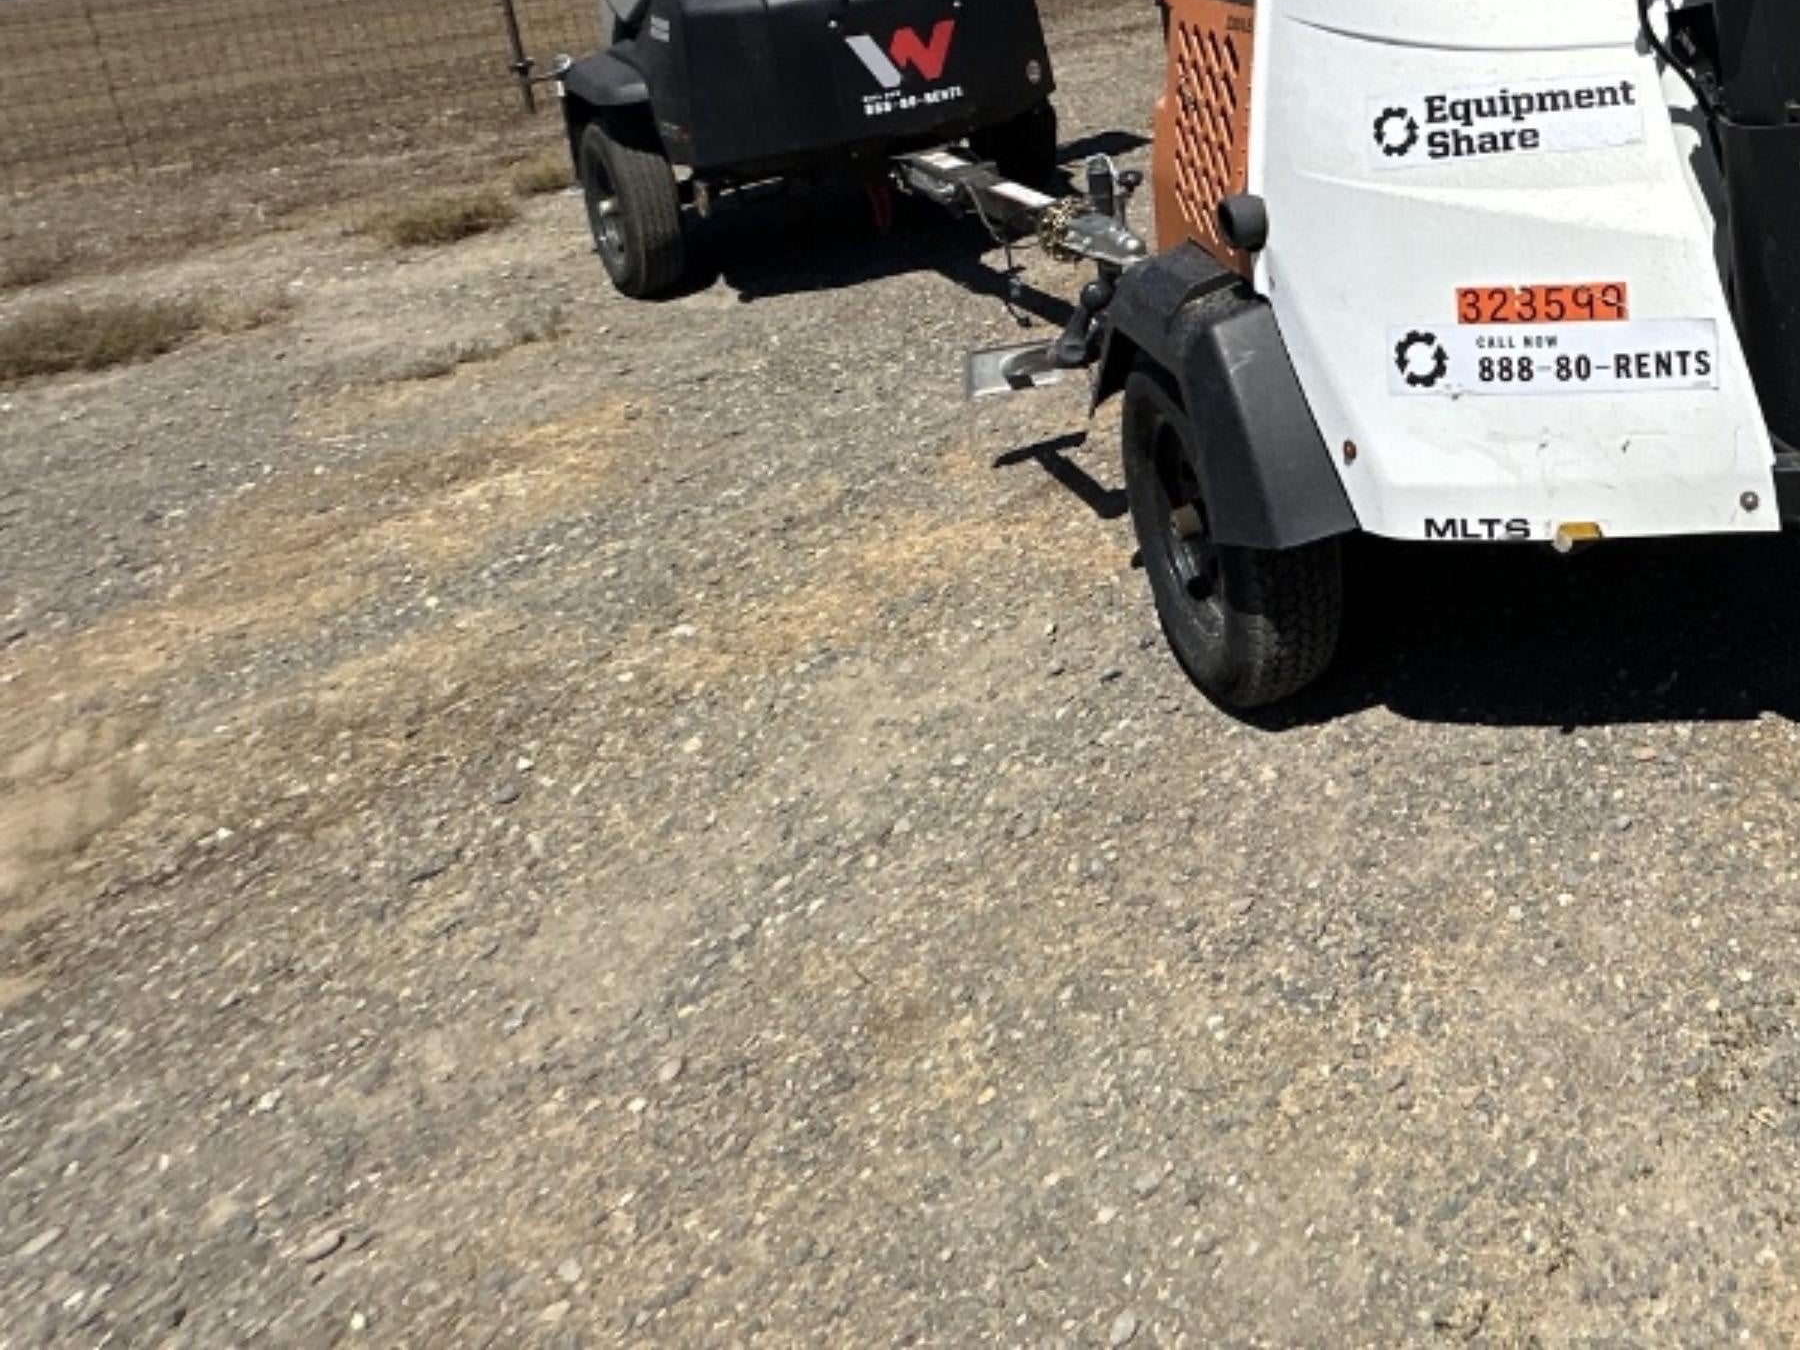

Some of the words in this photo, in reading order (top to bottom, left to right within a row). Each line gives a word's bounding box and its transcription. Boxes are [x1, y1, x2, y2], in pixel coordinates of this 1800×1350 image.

[1424, 80, 1635, 126] Equipment
[1426, 127, 1540, 159] Share
[1459, 284, 1625, 323] 323599
[1475, 336, 1516, 349] CALL
[1523, 335, 1558, 348] NOW
[1477, 351, 1711, 382] 888-80-RENTS
[1424, 518, 1531, 538] MLTS
